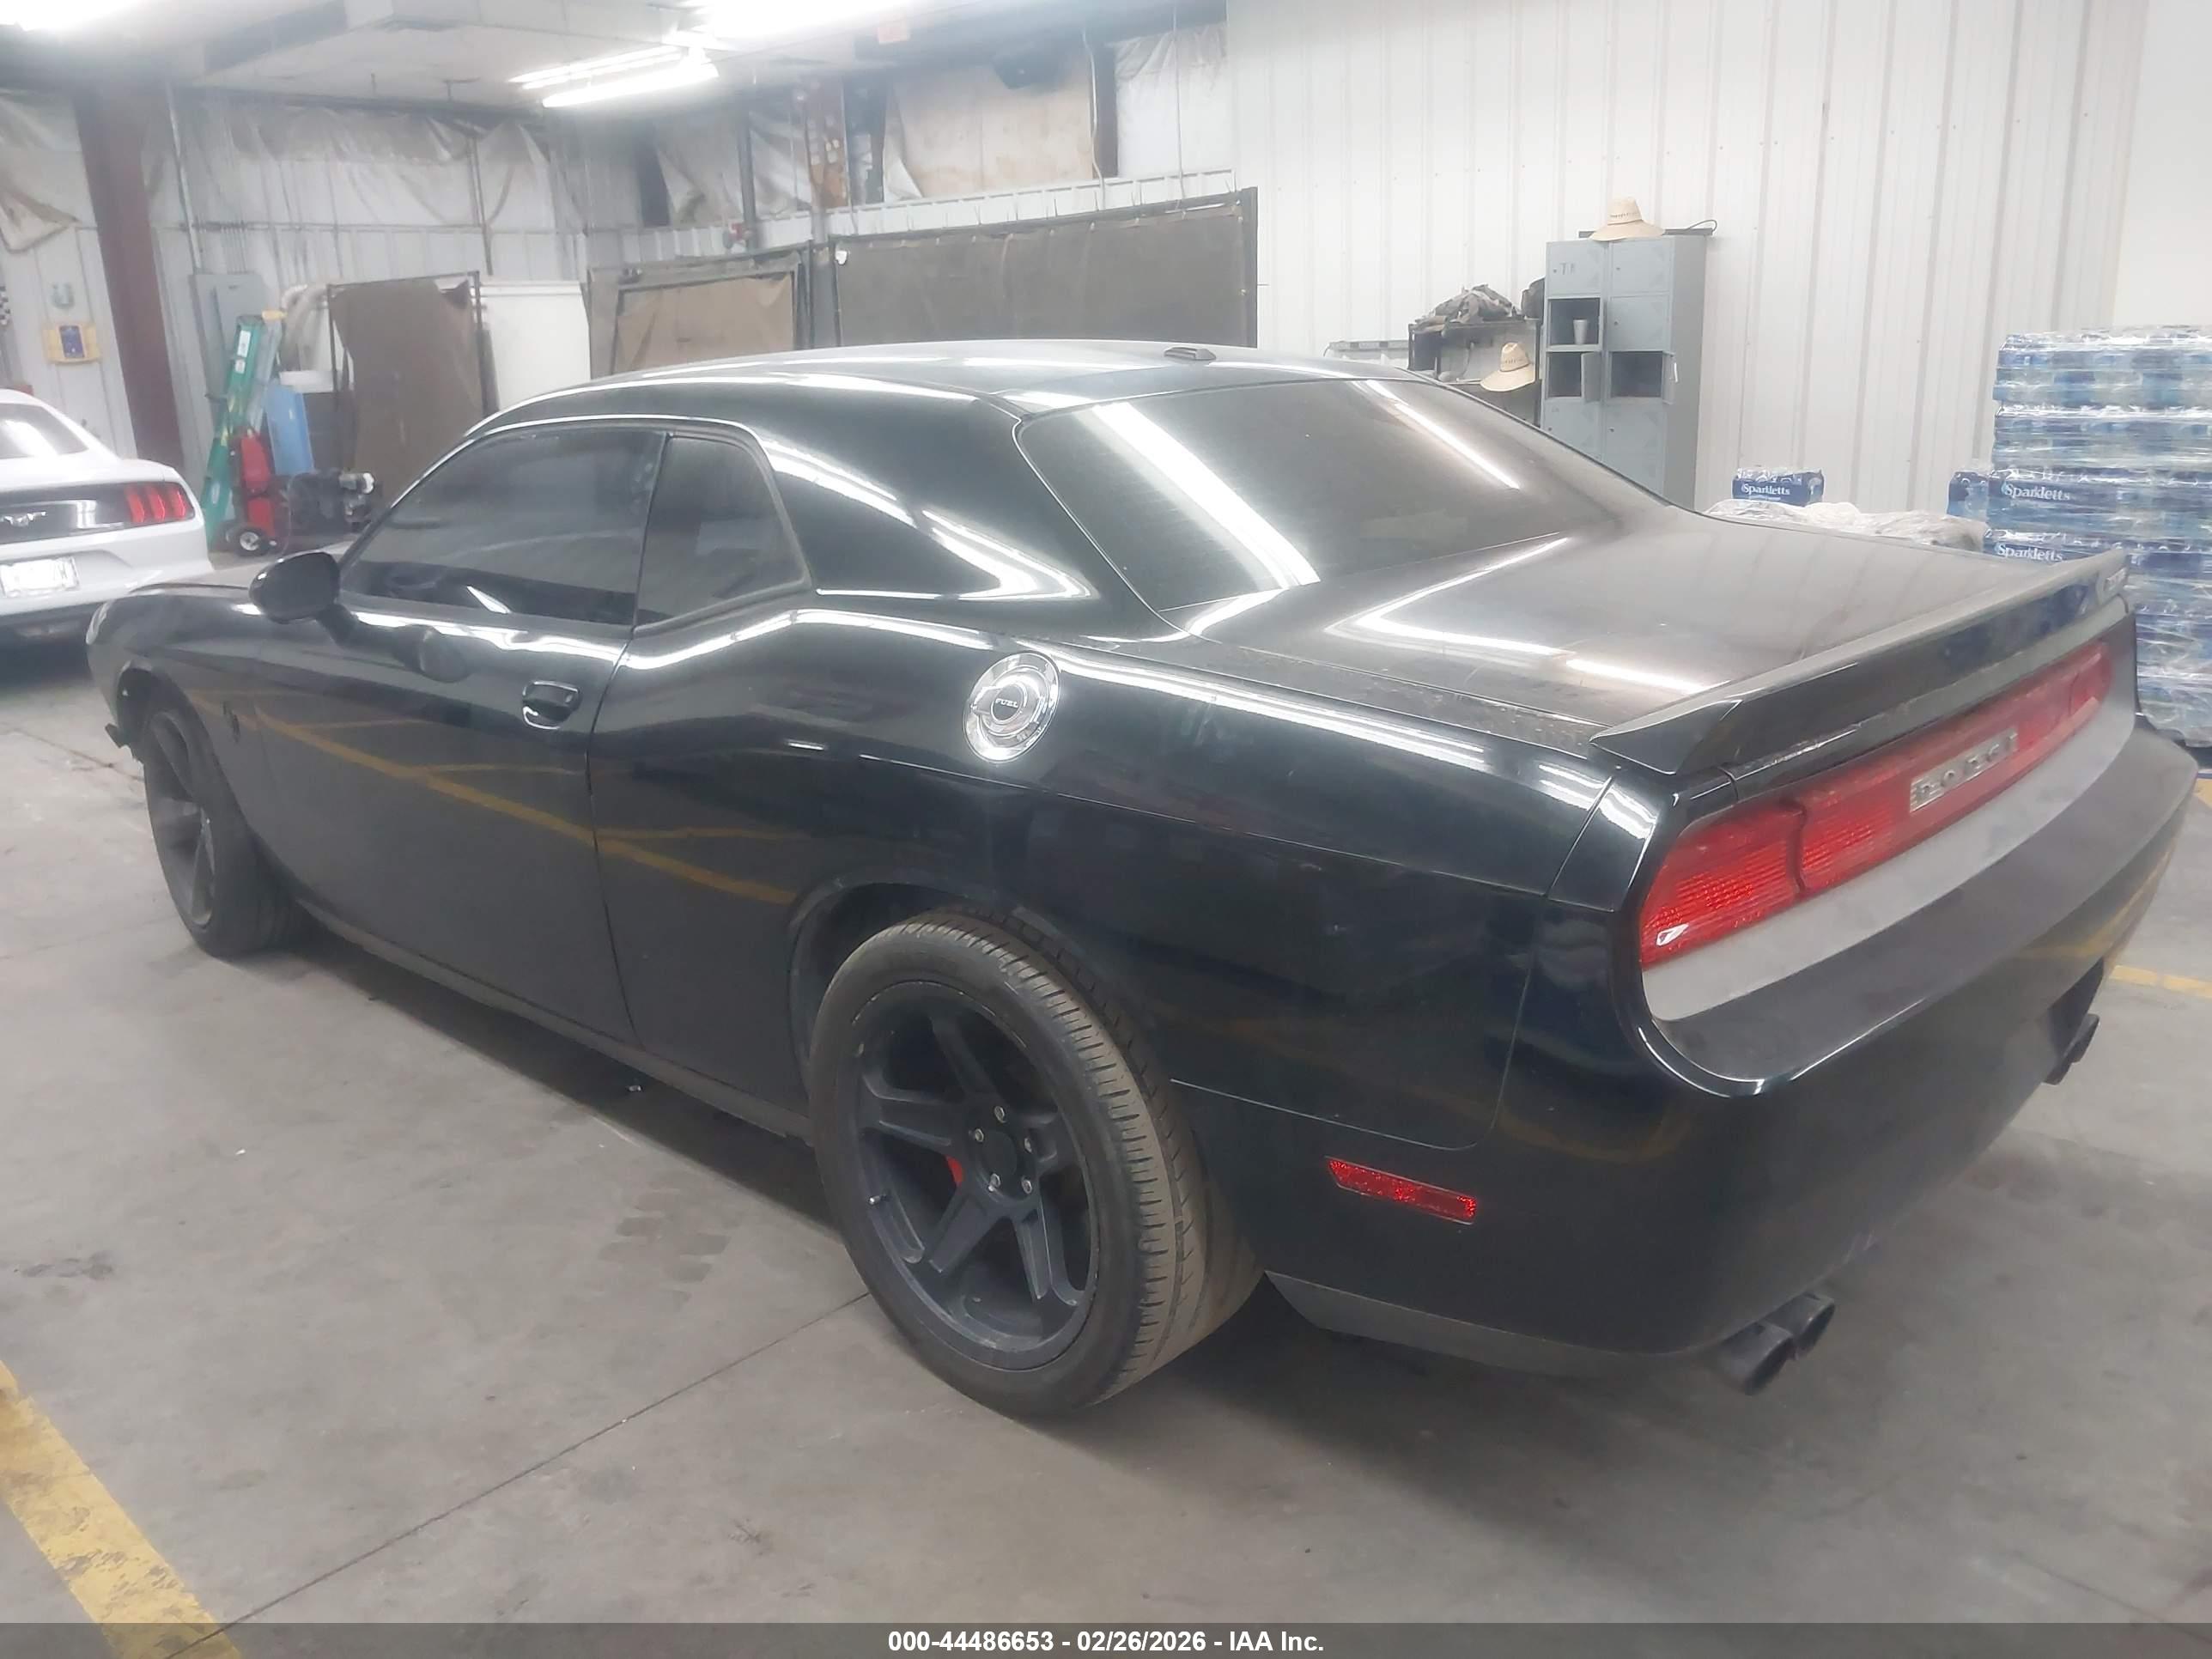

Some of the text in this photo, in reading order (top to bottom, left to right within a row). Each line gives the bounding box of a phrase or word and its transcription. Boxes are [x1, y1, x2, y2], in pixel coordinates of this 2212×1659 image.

[1741, 483, 1790, 495] Sparkletts
[2003, 483, 2070, 501] Sparkletts
[1996, 543, 2063, 562] Sparkletts
